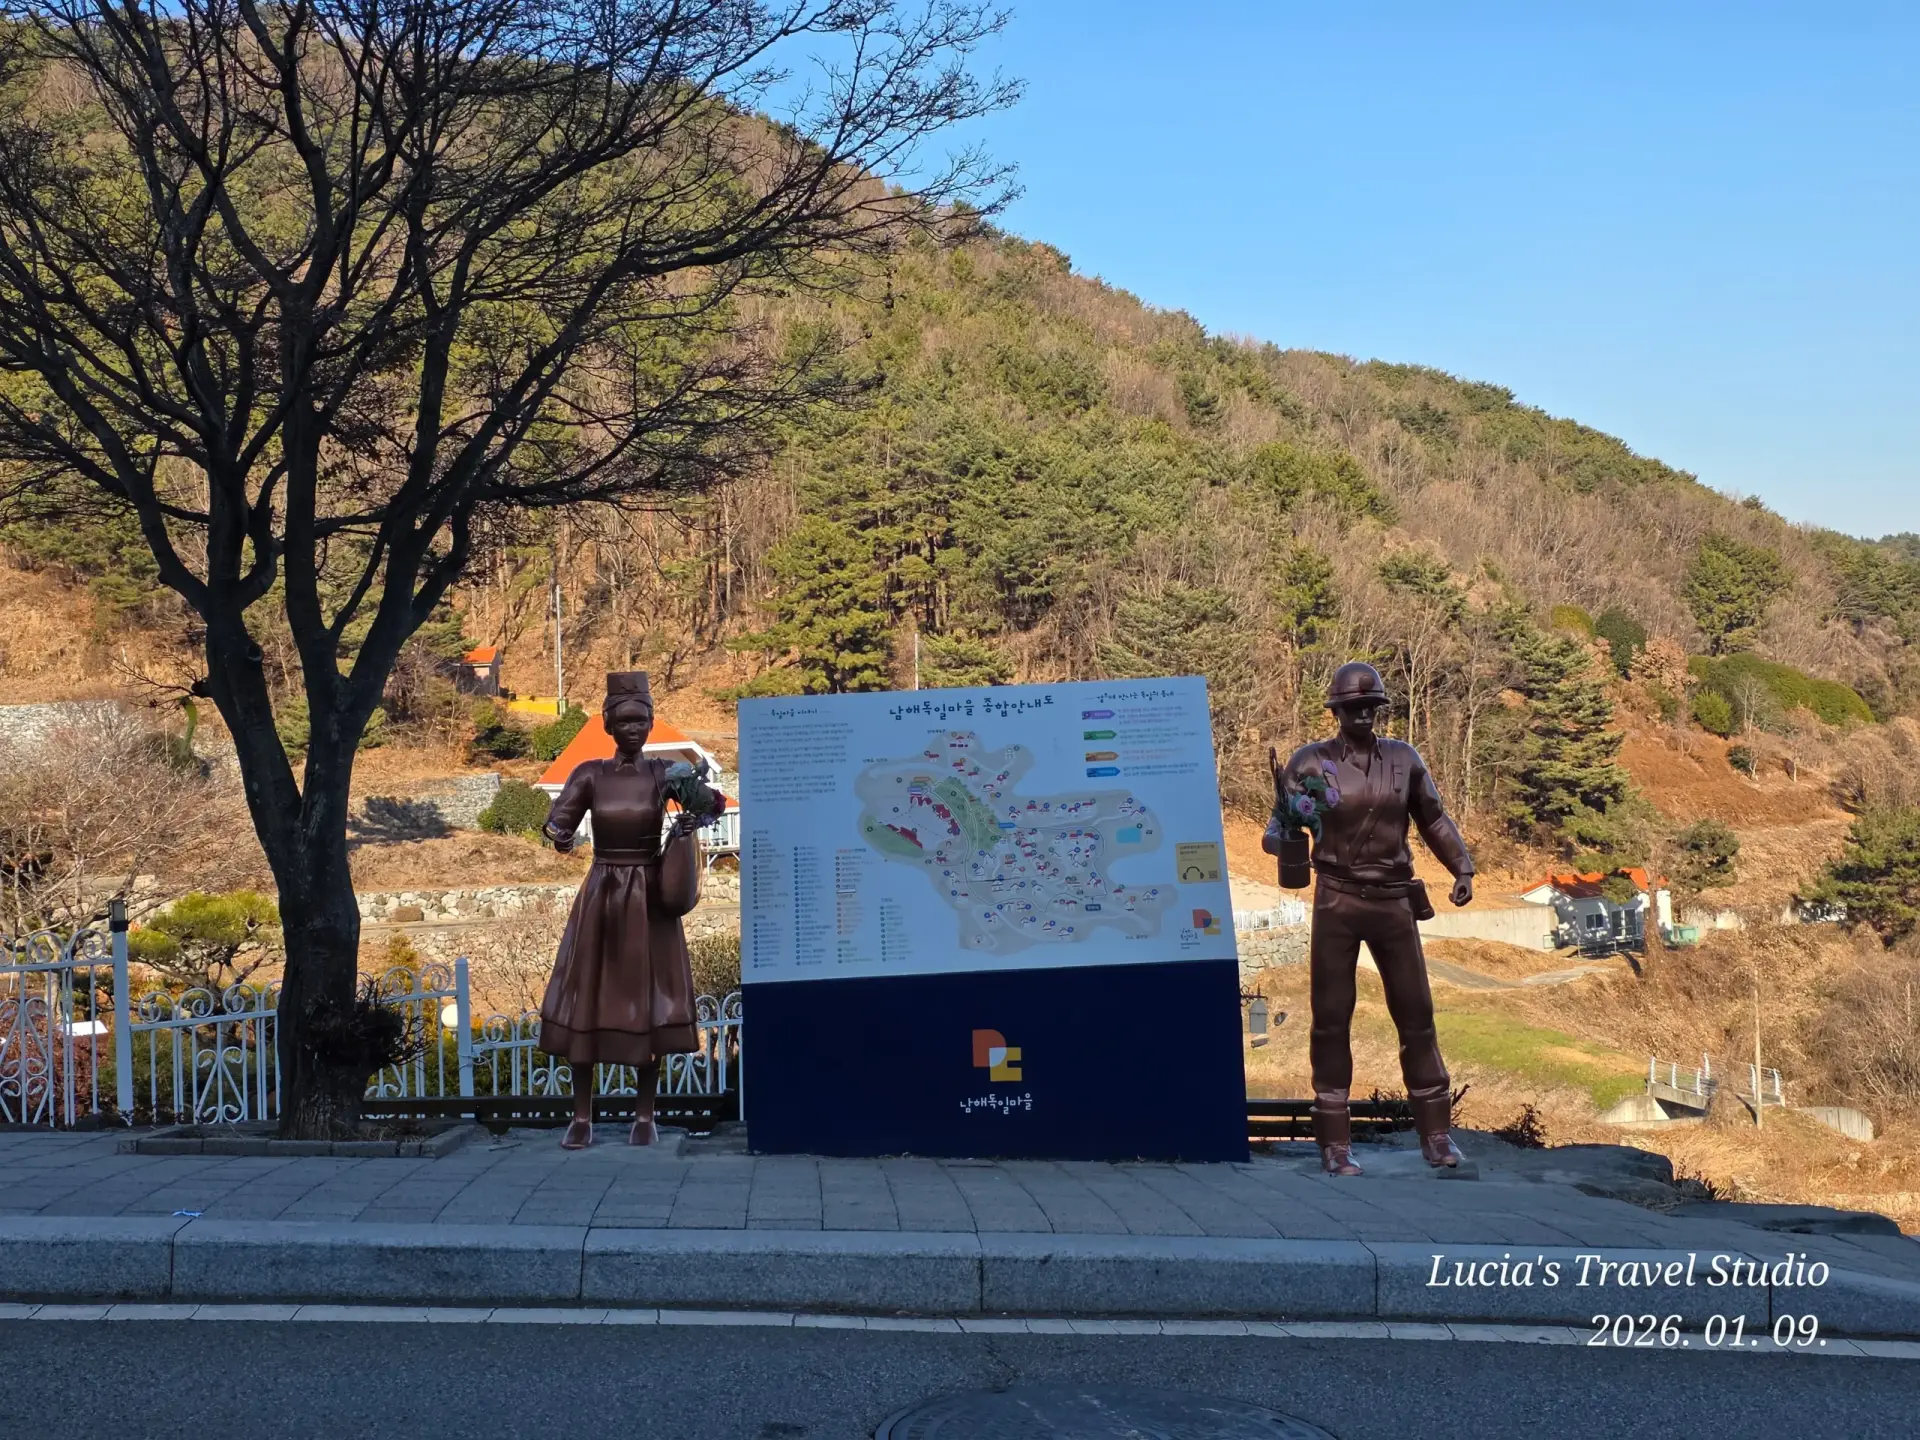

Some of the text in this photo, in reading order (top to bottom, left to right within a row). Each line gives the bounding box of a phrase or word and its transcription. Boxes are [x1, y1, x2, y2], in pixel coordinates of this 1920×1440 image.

[889, 695, 1054, 721] 남해독일마을 종합안내도
[960, 1092, 1033, 1115] 남해독일마을
